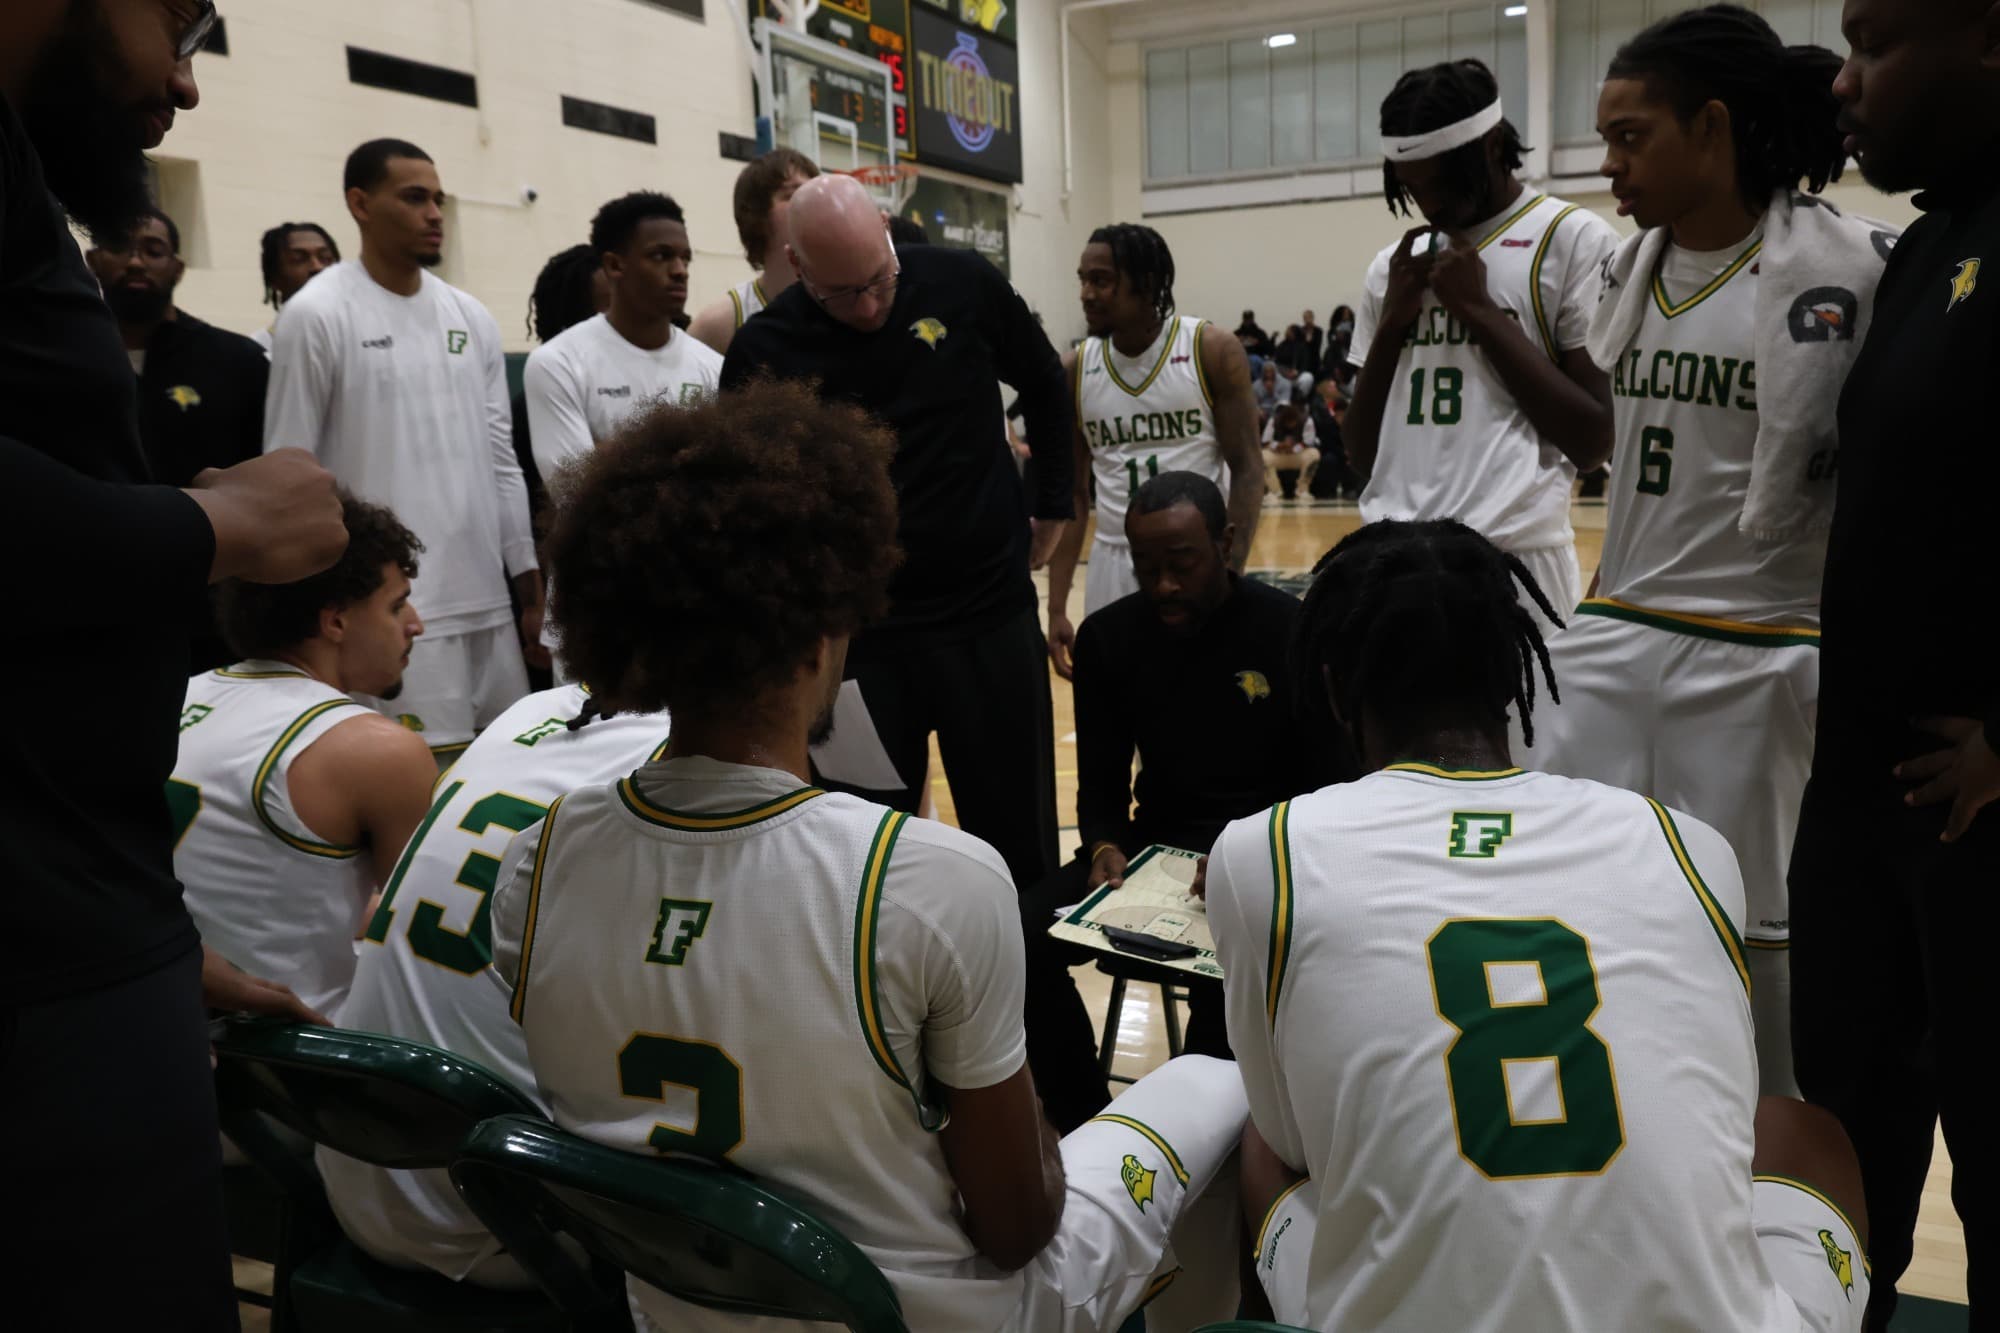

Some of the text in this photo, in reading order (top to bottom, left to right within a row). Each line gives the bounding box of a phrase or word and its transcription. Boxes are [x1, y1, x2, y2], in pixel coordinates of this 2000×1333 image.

[917, 49, 1013, 134] TIMEOUT
[447, 329, 467, 354] F
[1407, 367, 1463, 425] 18
[1613, 349, 1758, 411] ALCONS
[1086, 408, 1202, 448] FALCONS
[1637, 426, 1674, 496] 6
[1449, 812, 1512, 858] F
[363, 779, 551, 977] 13
[645, 897, 713, 966] F
[1424, 916, 1627, 1181] 8
